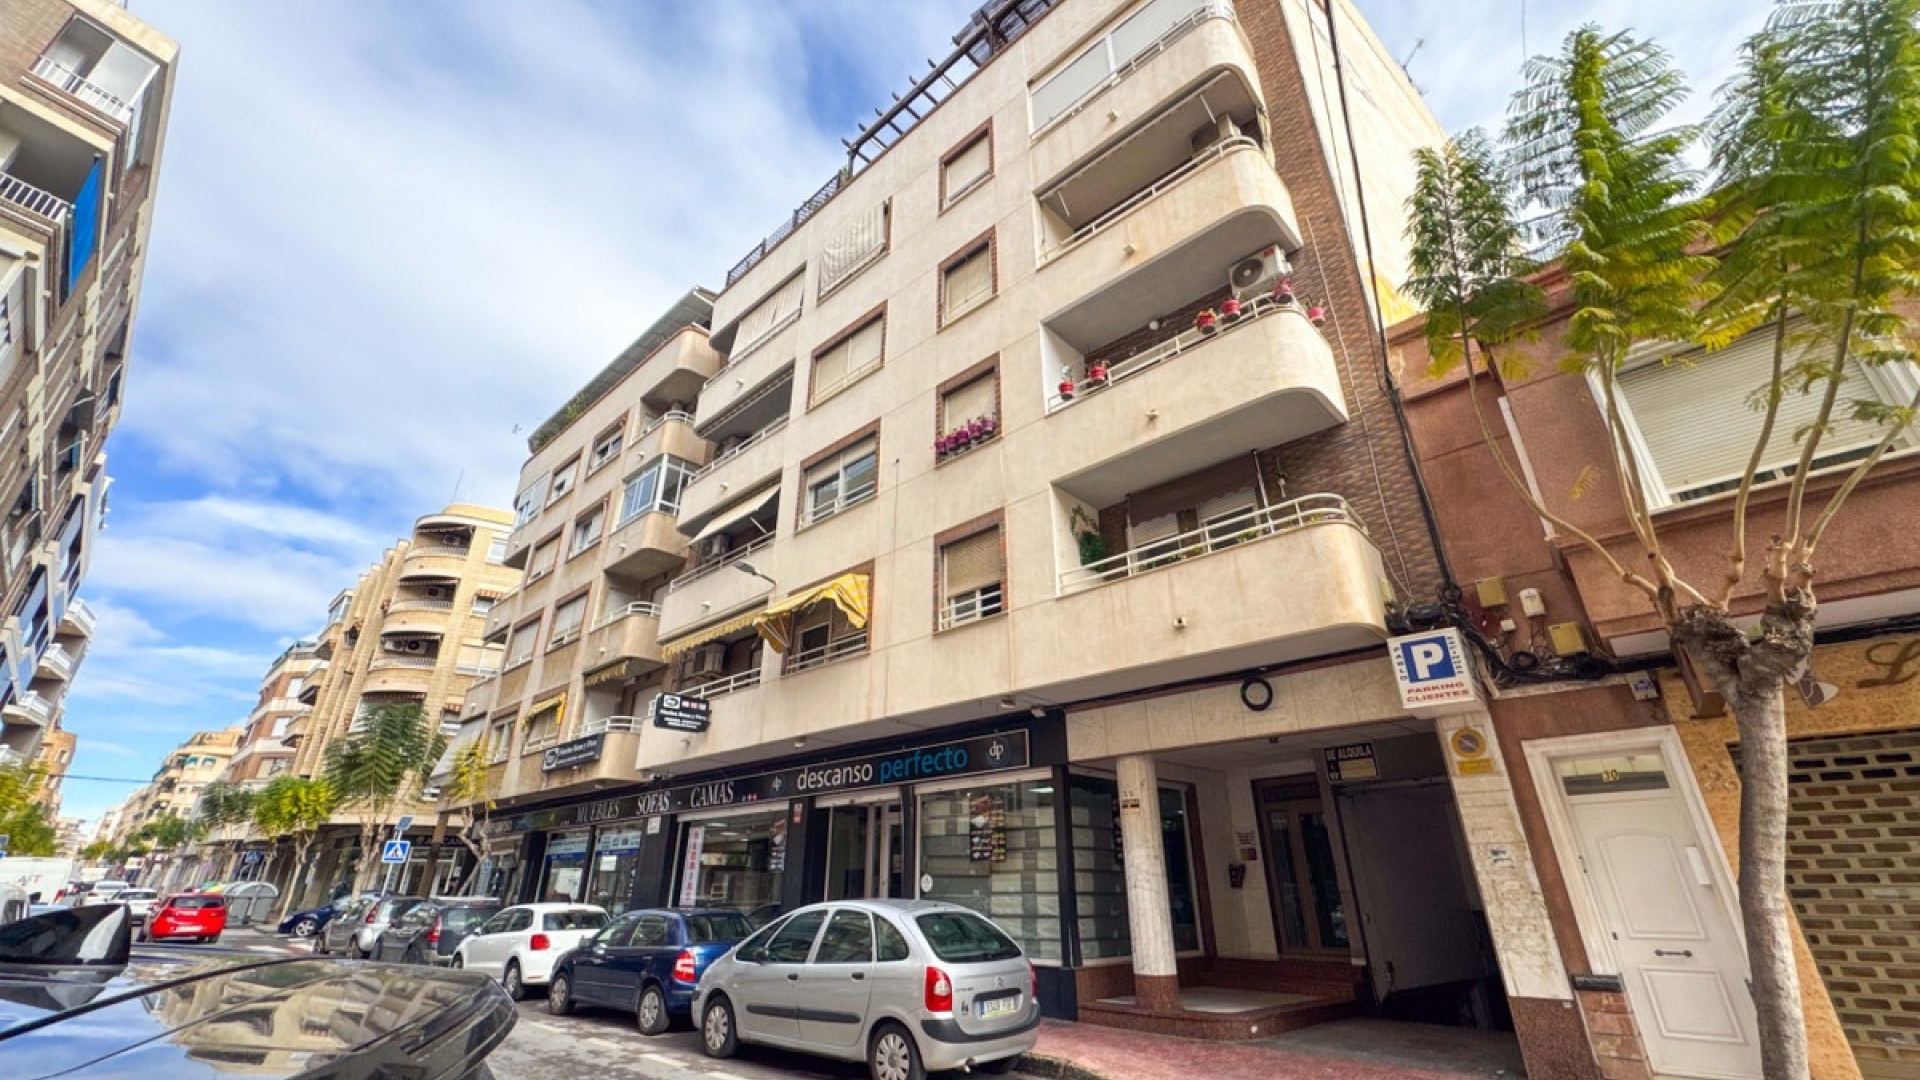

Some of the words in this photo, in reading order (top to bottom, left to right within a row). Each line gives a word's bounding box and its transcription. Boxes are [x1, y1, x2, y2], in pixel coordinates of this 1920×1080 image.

[1407, 681, 1464, 694] PARKING
[1407, 689, 1469, 702] CLIENTES
[796, 763, 873, 790] descanso
[879, 747, 968, 784] perfecto
[637, 791, 671, 815] SOFAS
[690, 781, 734, 808] CAMAS
